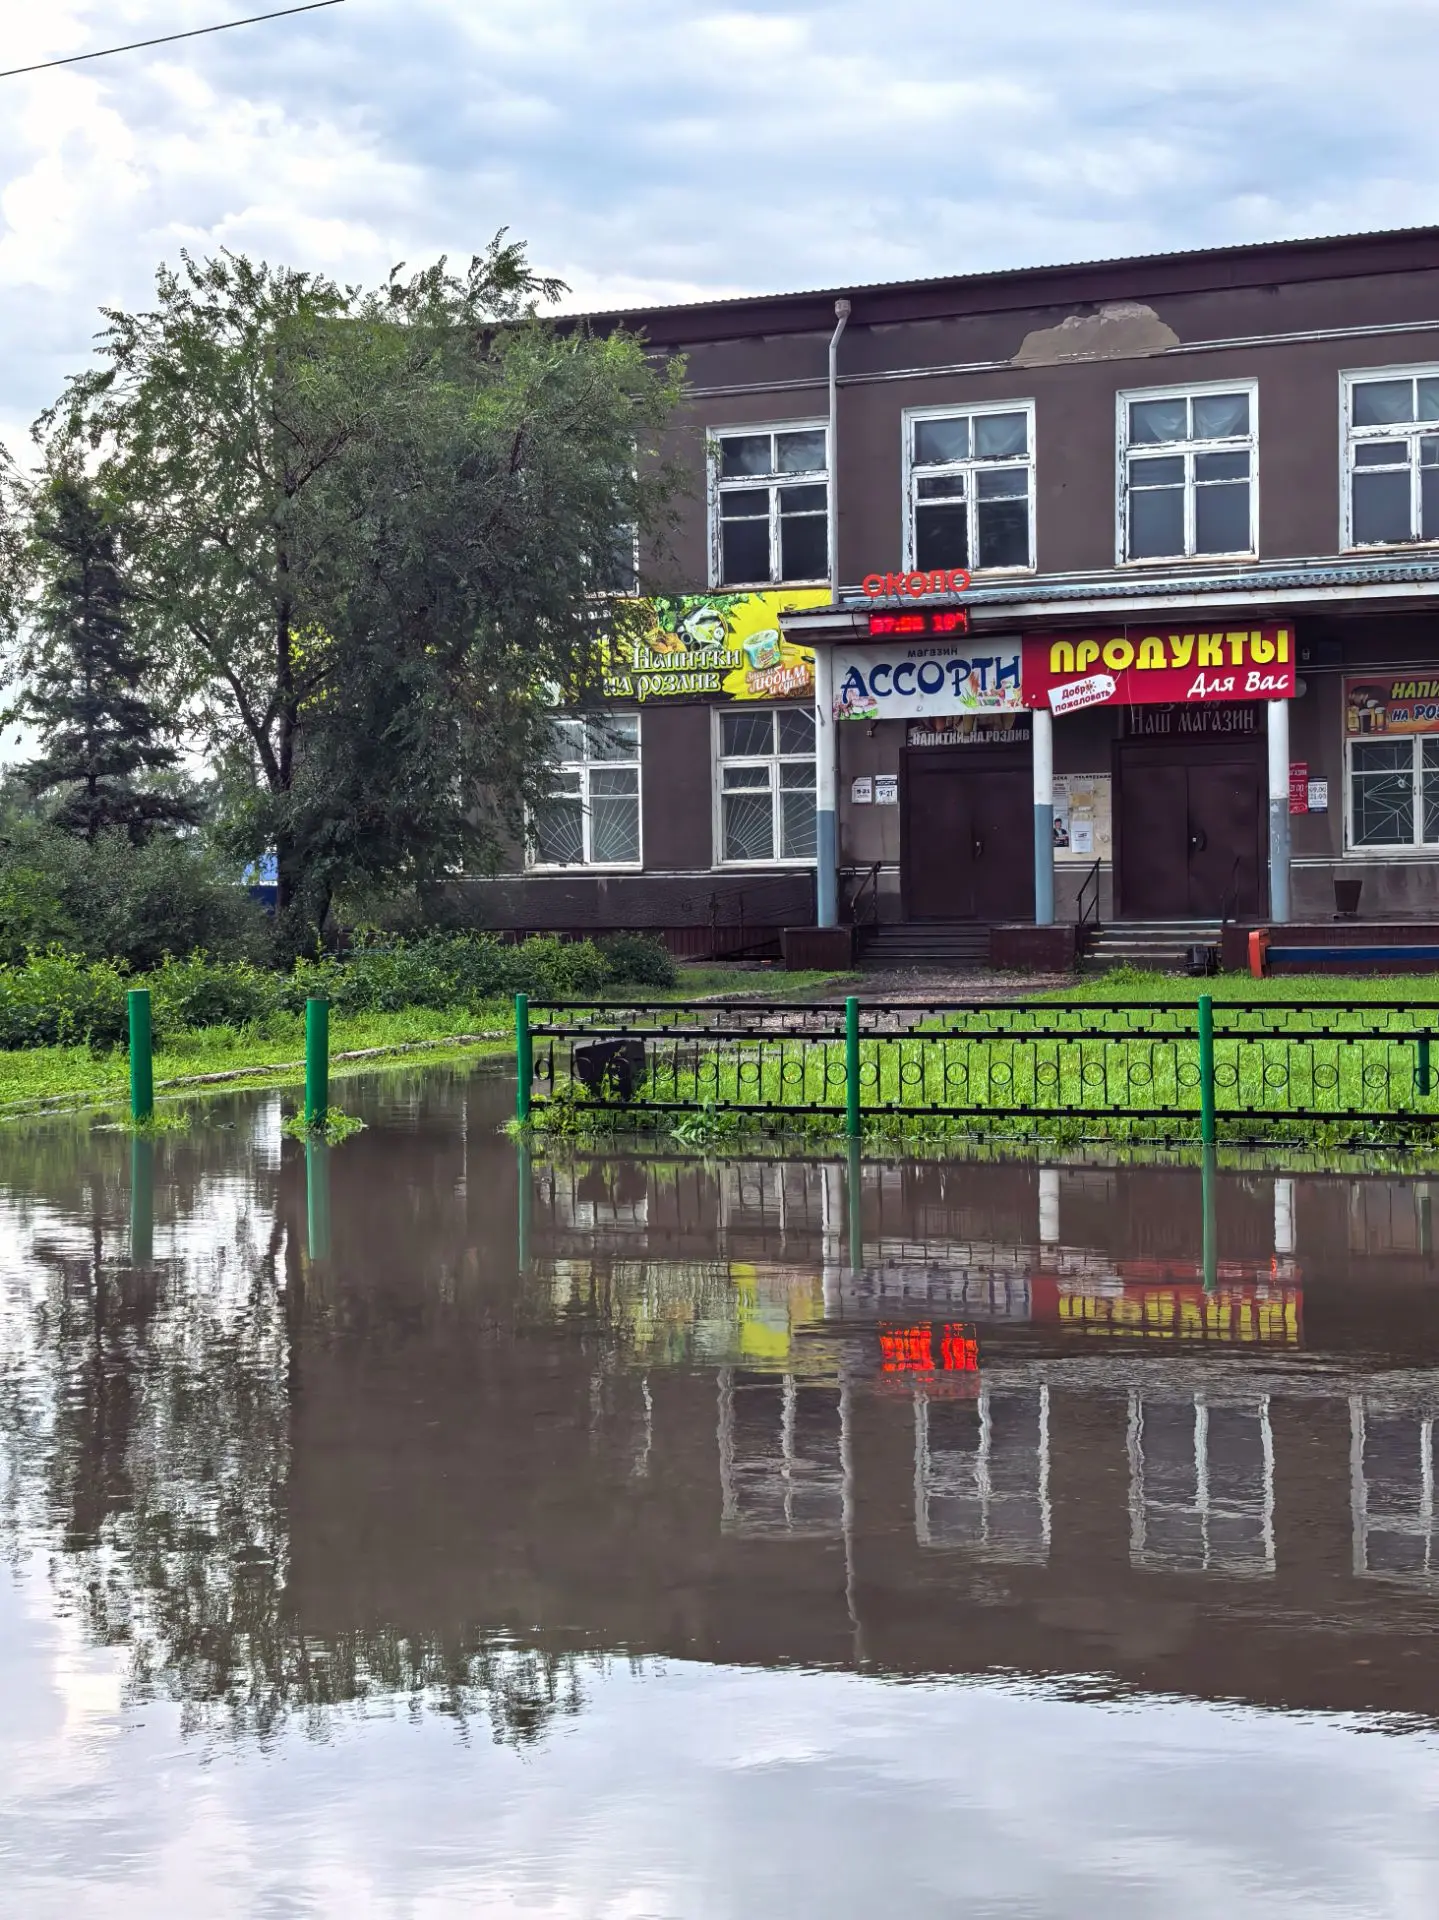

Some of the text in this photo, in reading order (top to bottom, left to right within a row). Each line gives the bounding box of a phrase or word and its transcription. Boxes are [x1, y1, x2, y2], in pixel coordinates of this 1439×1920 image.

[863, 568, 971, 597] ОКОЛО
[907, 647, 958, 658] магазин
[1050, 629, 1289, 673] ПРОДУКТЫ
[840, 655, 1021, 704] АССОРТИ
[1187, 671, 1289, 698] Для Вас
[1055, 689, 1112, 712] пожаловать
[1413, 703, 1439, 722] РО
[912, 729, 1030, 747] НАПИТКИ НА РОЗЛИВ
